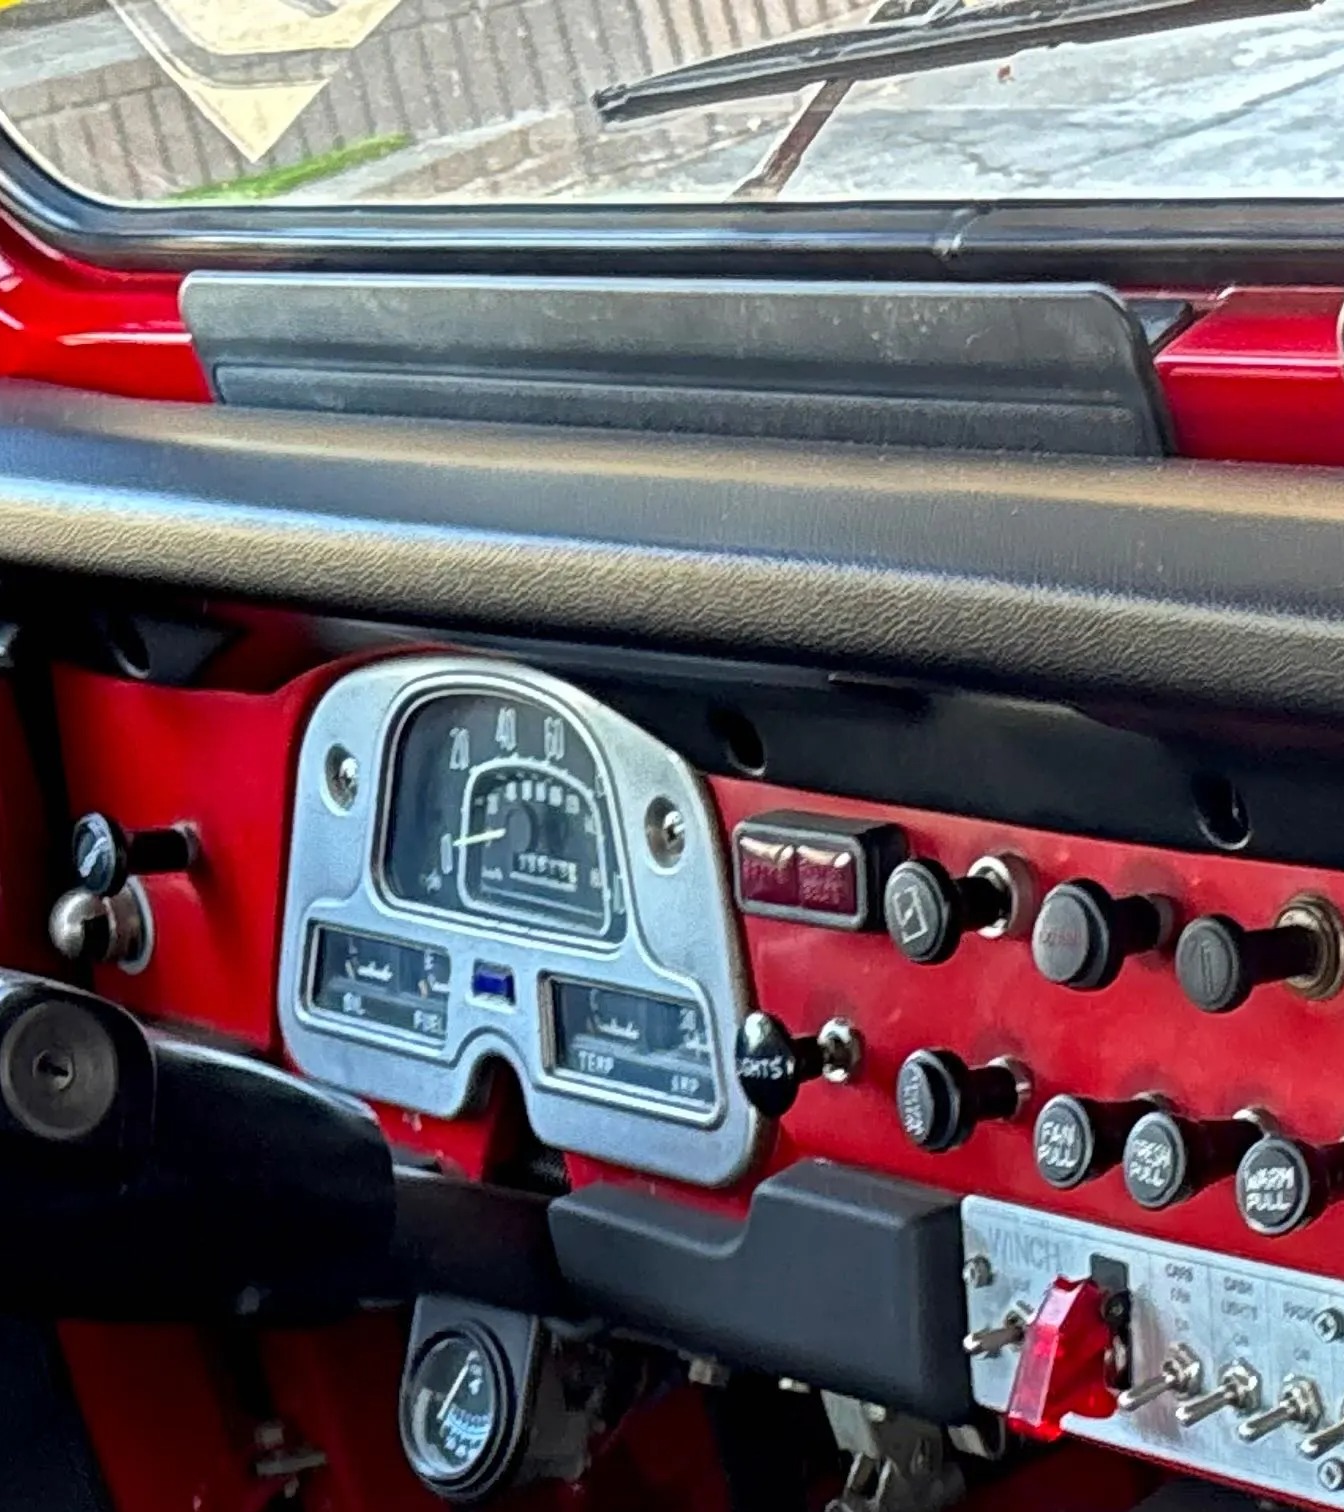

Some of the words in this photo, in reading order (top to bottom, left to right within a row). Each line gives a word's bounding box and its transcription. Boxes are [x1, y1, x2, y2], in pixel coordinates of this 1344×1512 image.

[494, 707, 517, 752] 40
[543, 716, 565, 762] 60
[448, 726, 471, 771] 20
[413, 1009, 445, 1037] FUEL
[578, 1051, 615, 1075] TEMP
[1042, 1121, 1077, 1146] FAN
[1037, 1144, 1078, 1168] PULL
[1246, 1190, 1292, 1213] PULL
